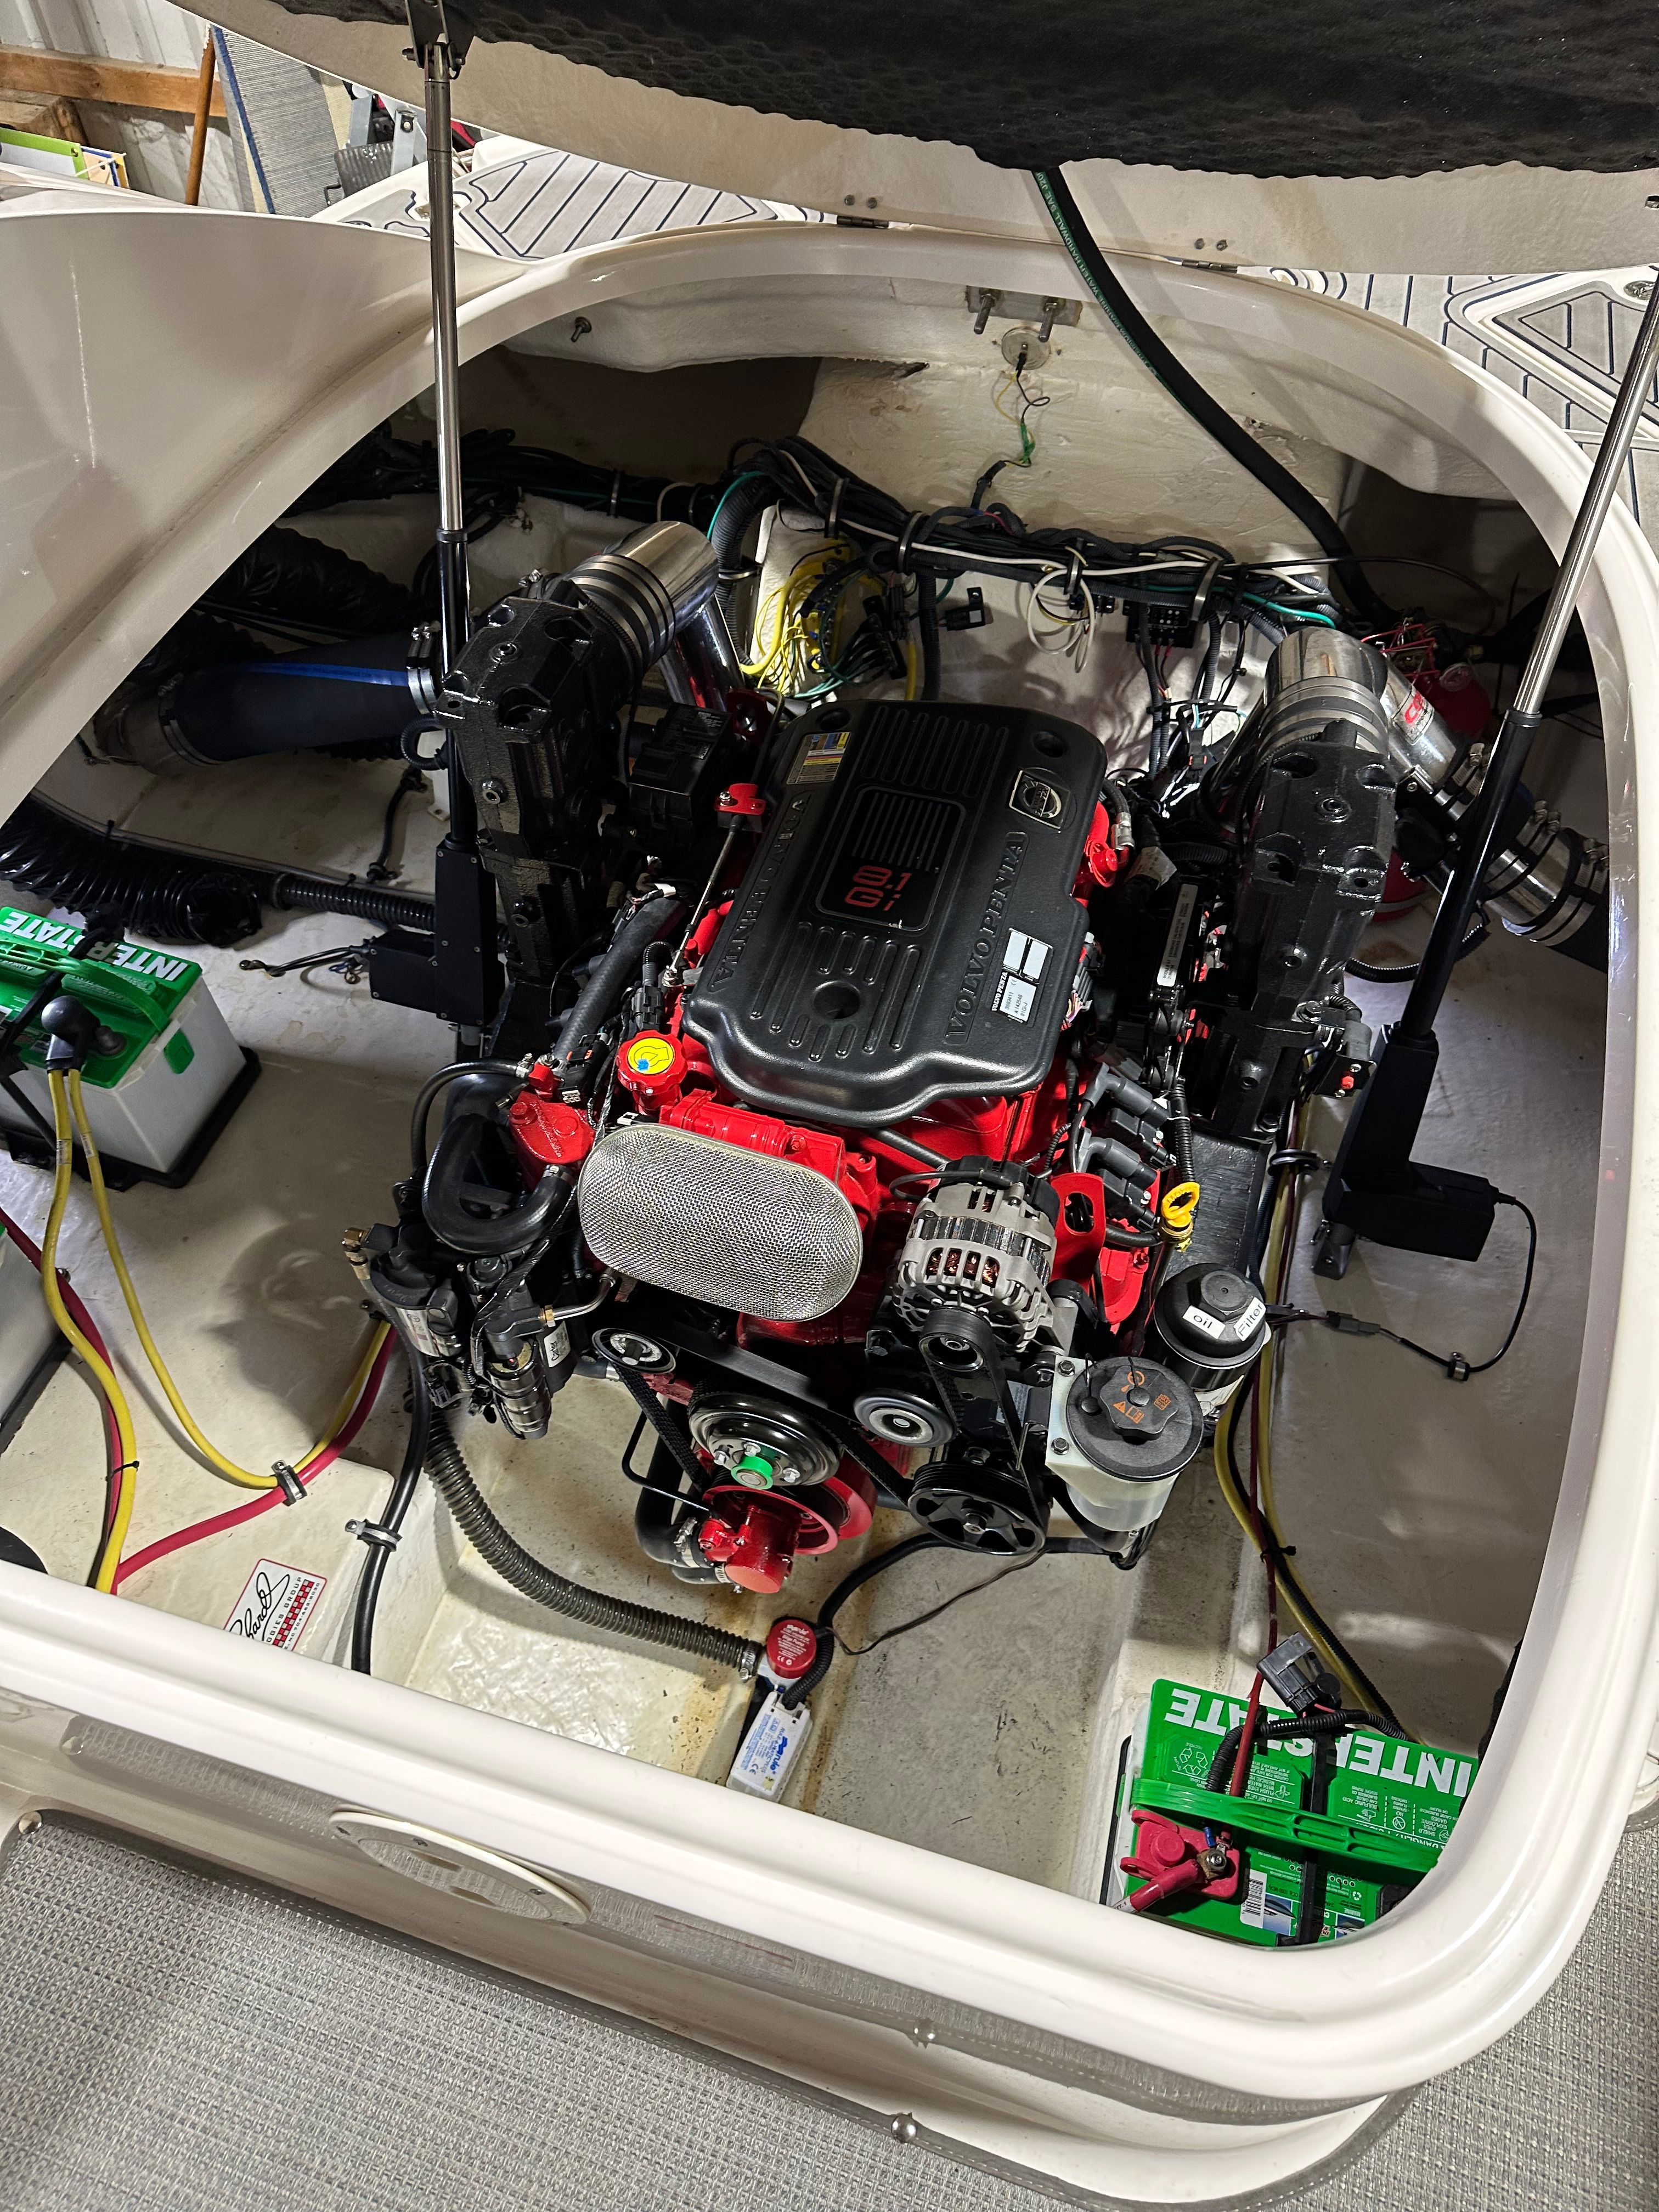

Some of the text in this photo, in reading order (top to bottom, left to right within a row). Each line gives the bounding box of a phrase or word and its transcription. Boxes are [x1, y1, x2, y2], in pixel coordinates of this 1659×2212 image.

[1044, 191, 1058, 211] SAE
[1053, 212, 1081, 263] HARDWALL
[1078, 264, 1100, 295] WATER
[852, 864, 912, 891] 8.1
[844, 885, 901, 912] Gi
[944, 834, 1025, 1040] VOLVO PENTA
[991, 971, 1008, 1012] VOLVO PENTA
[1238, 1303, 1262, 1336] Filter
[550, 1340, 559, 1360] Carter
[283, 1576, 303, 1607] GROUP
[289, 1632, 296, 1641] NC
[1247, 1779, 1262, 1787] WATER
[1255, 1776, 1275, 1786] MEDICAL
[1354, 1799, 1377, 1809] SULFURIC
[1418, 1827, 1436, 1836] SHIELD
[1420, 1818, 1447, 1829] EXPLOSIVE
[1423, 1823, 1436, 1831] EYES
